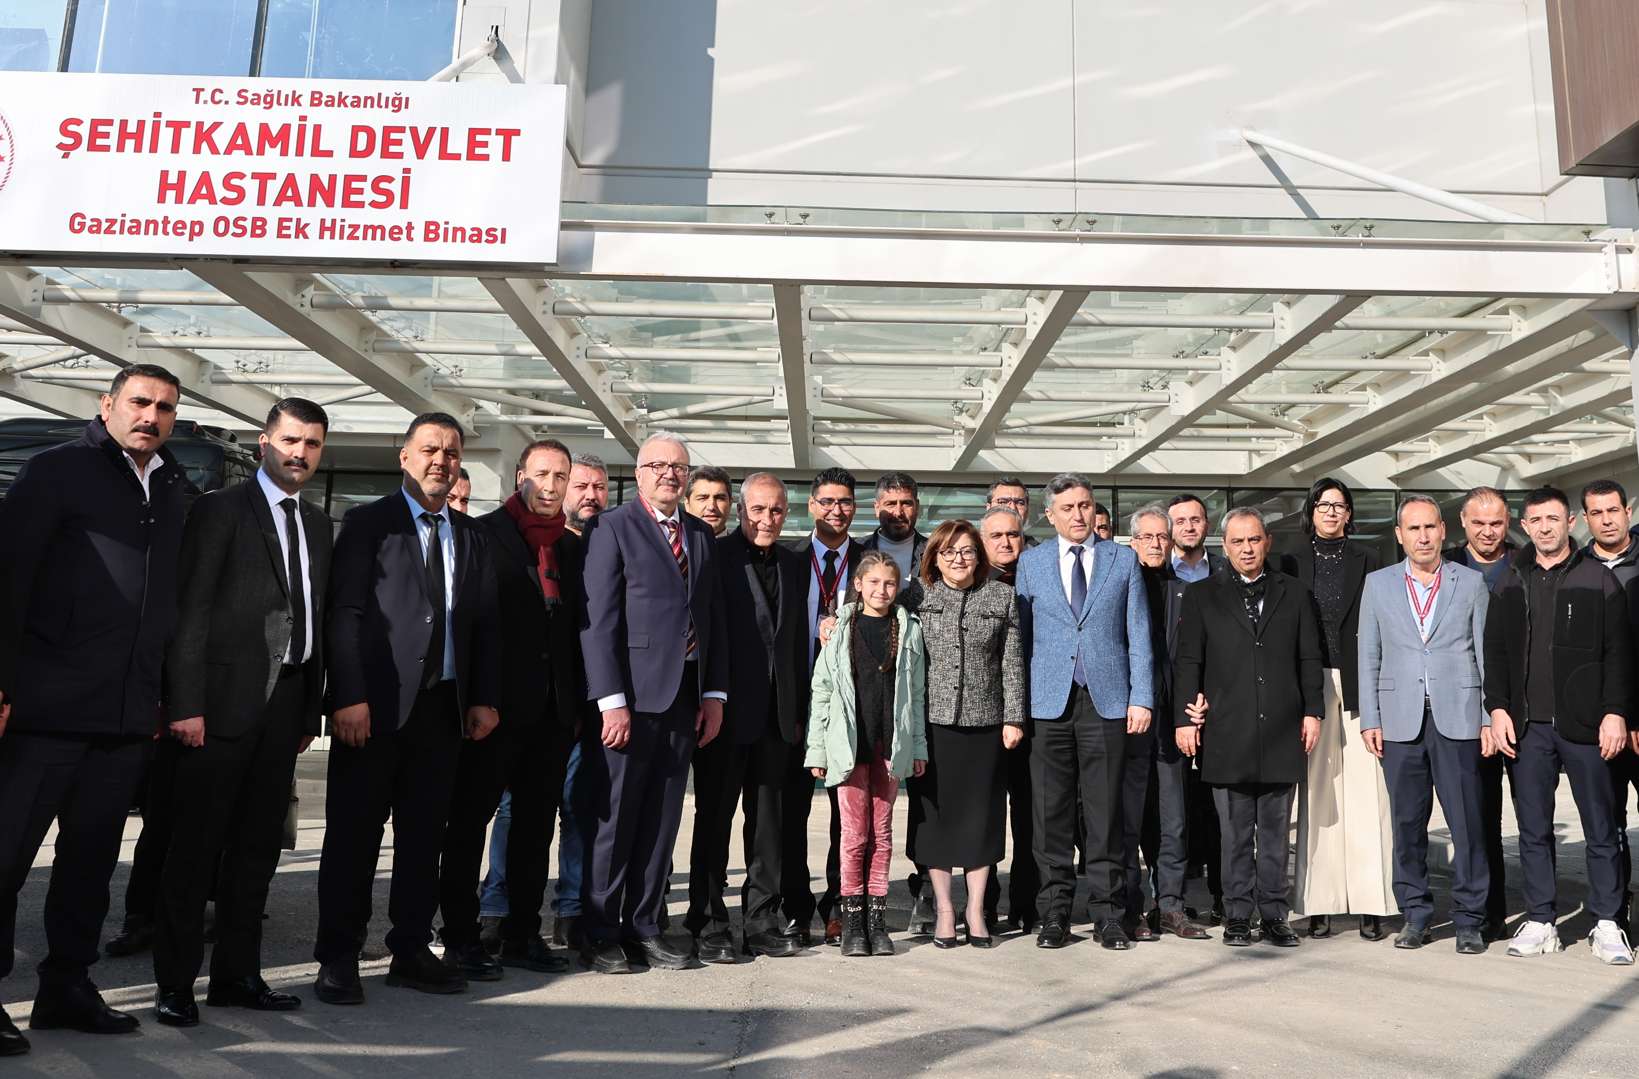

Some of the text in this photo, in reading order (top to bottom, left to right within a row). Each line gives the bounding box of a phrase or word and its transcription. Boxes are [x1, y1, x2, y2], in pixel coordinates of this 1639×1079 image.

[192, 87, 410, 114] T.C. Sağlık Bakanlığı
[55, 111, 522, 163] ŞEHİTKAMİL DEVLET
[156, 166, 413, 211] HASTANESİ
[68, 211, 508, 245] Gaziantep OSB Ek Hizmet Binası
